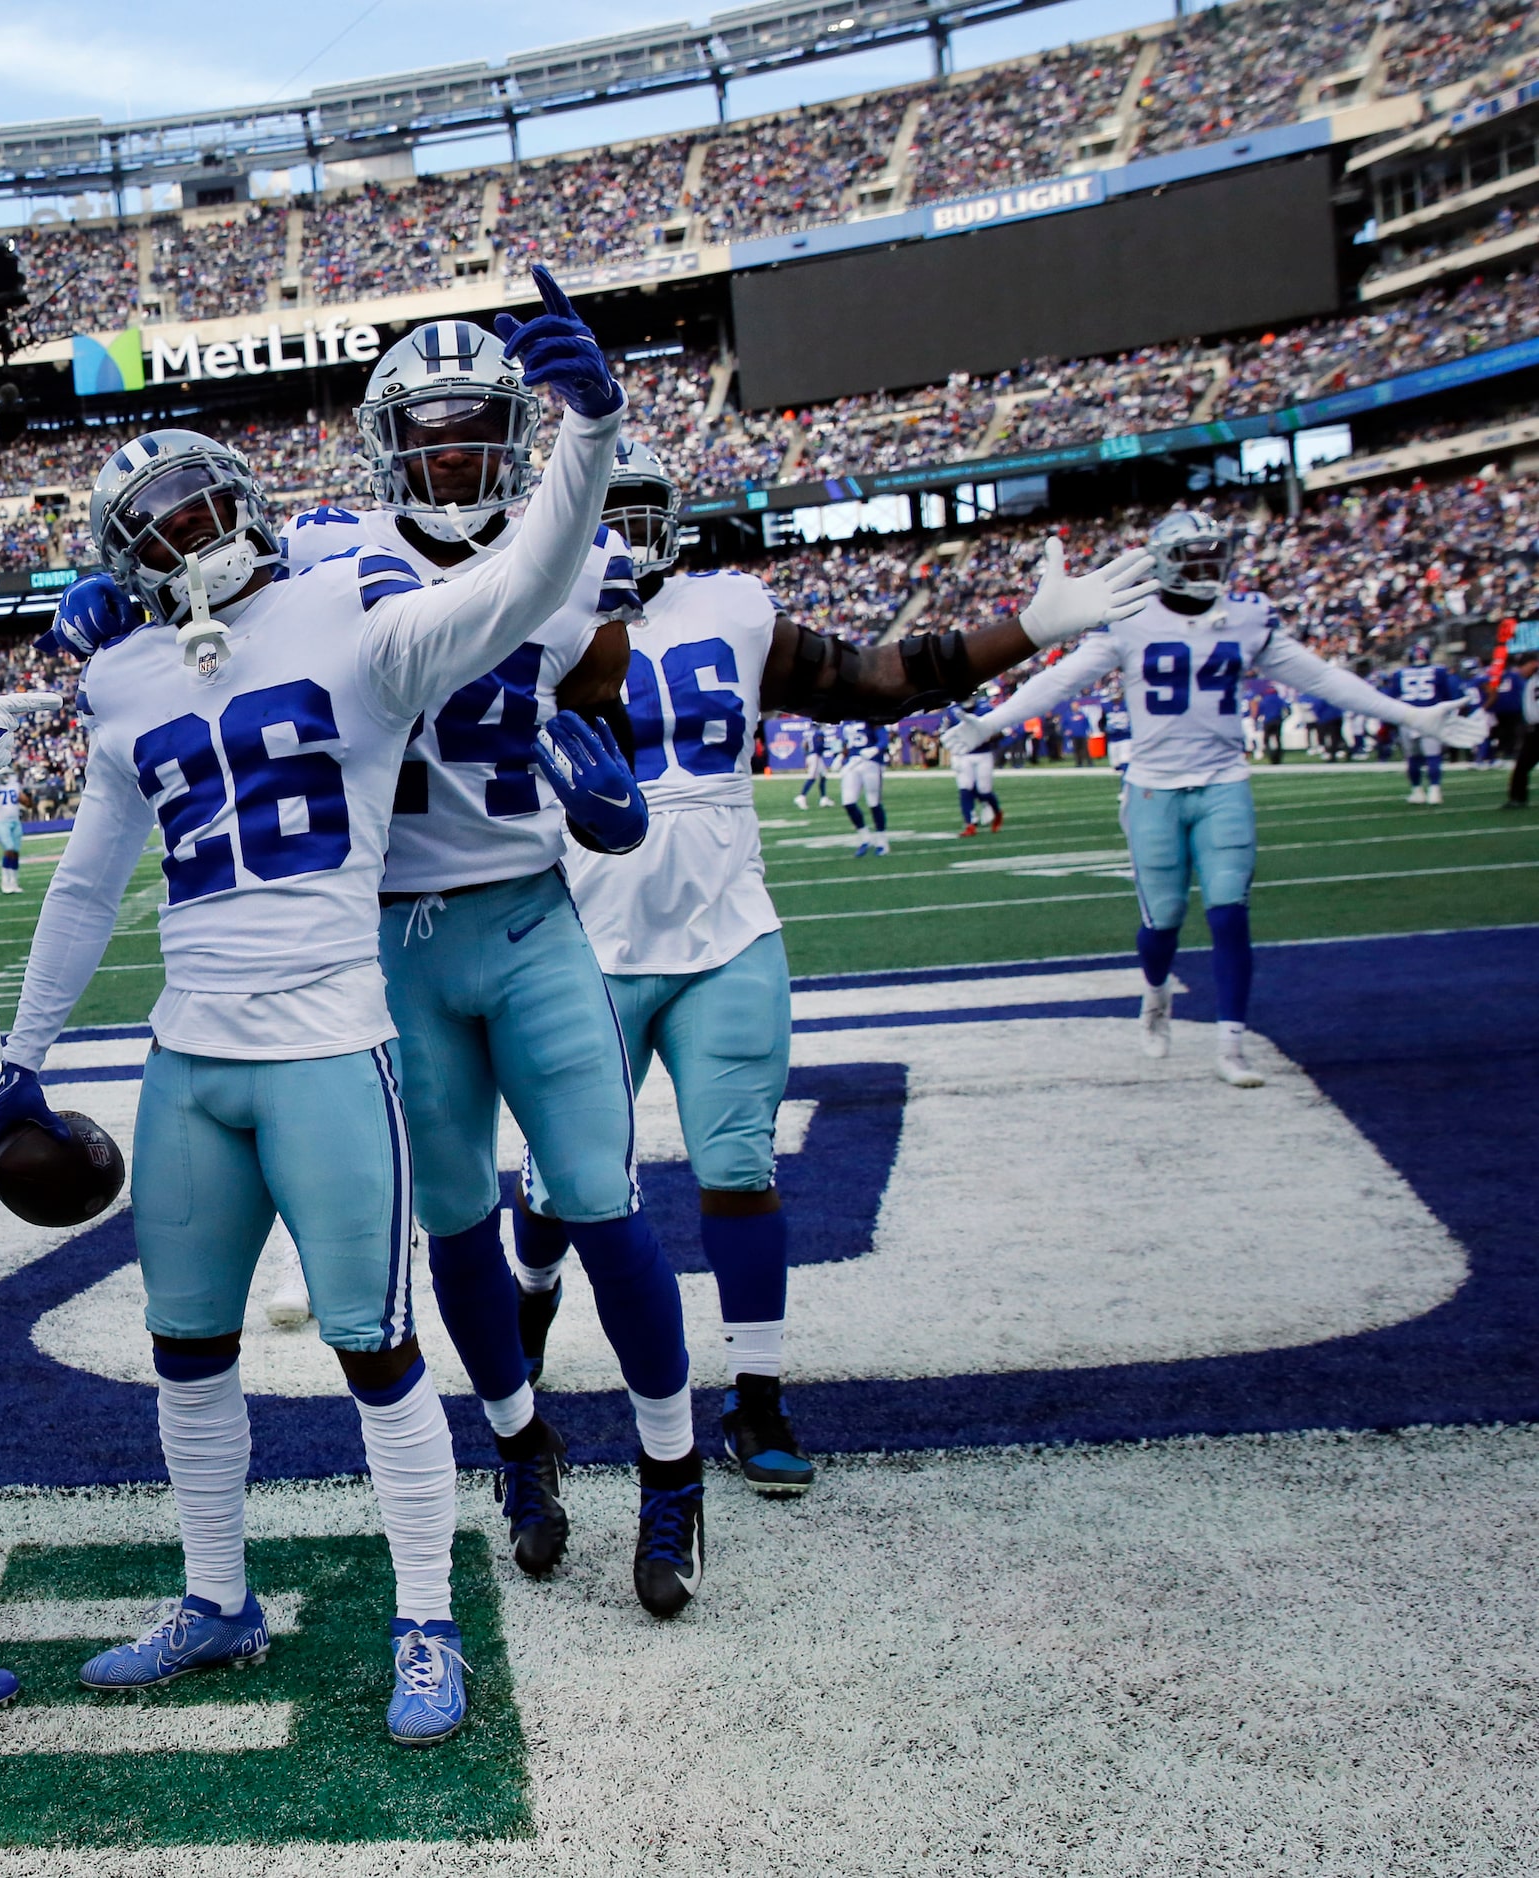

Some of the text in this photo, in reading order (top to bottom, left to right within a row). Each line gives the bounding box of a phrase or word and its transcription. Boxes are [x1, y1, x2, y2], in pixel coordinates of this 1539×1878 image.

[933, 176, 1092, 231] BUD LIGHT
[151, 315, 380, 384] MetLife
[31, 570, 78, 588] COWBOYS
[1143, 641, 1242, 715] 94
[133, 678, 352, 906] 26
